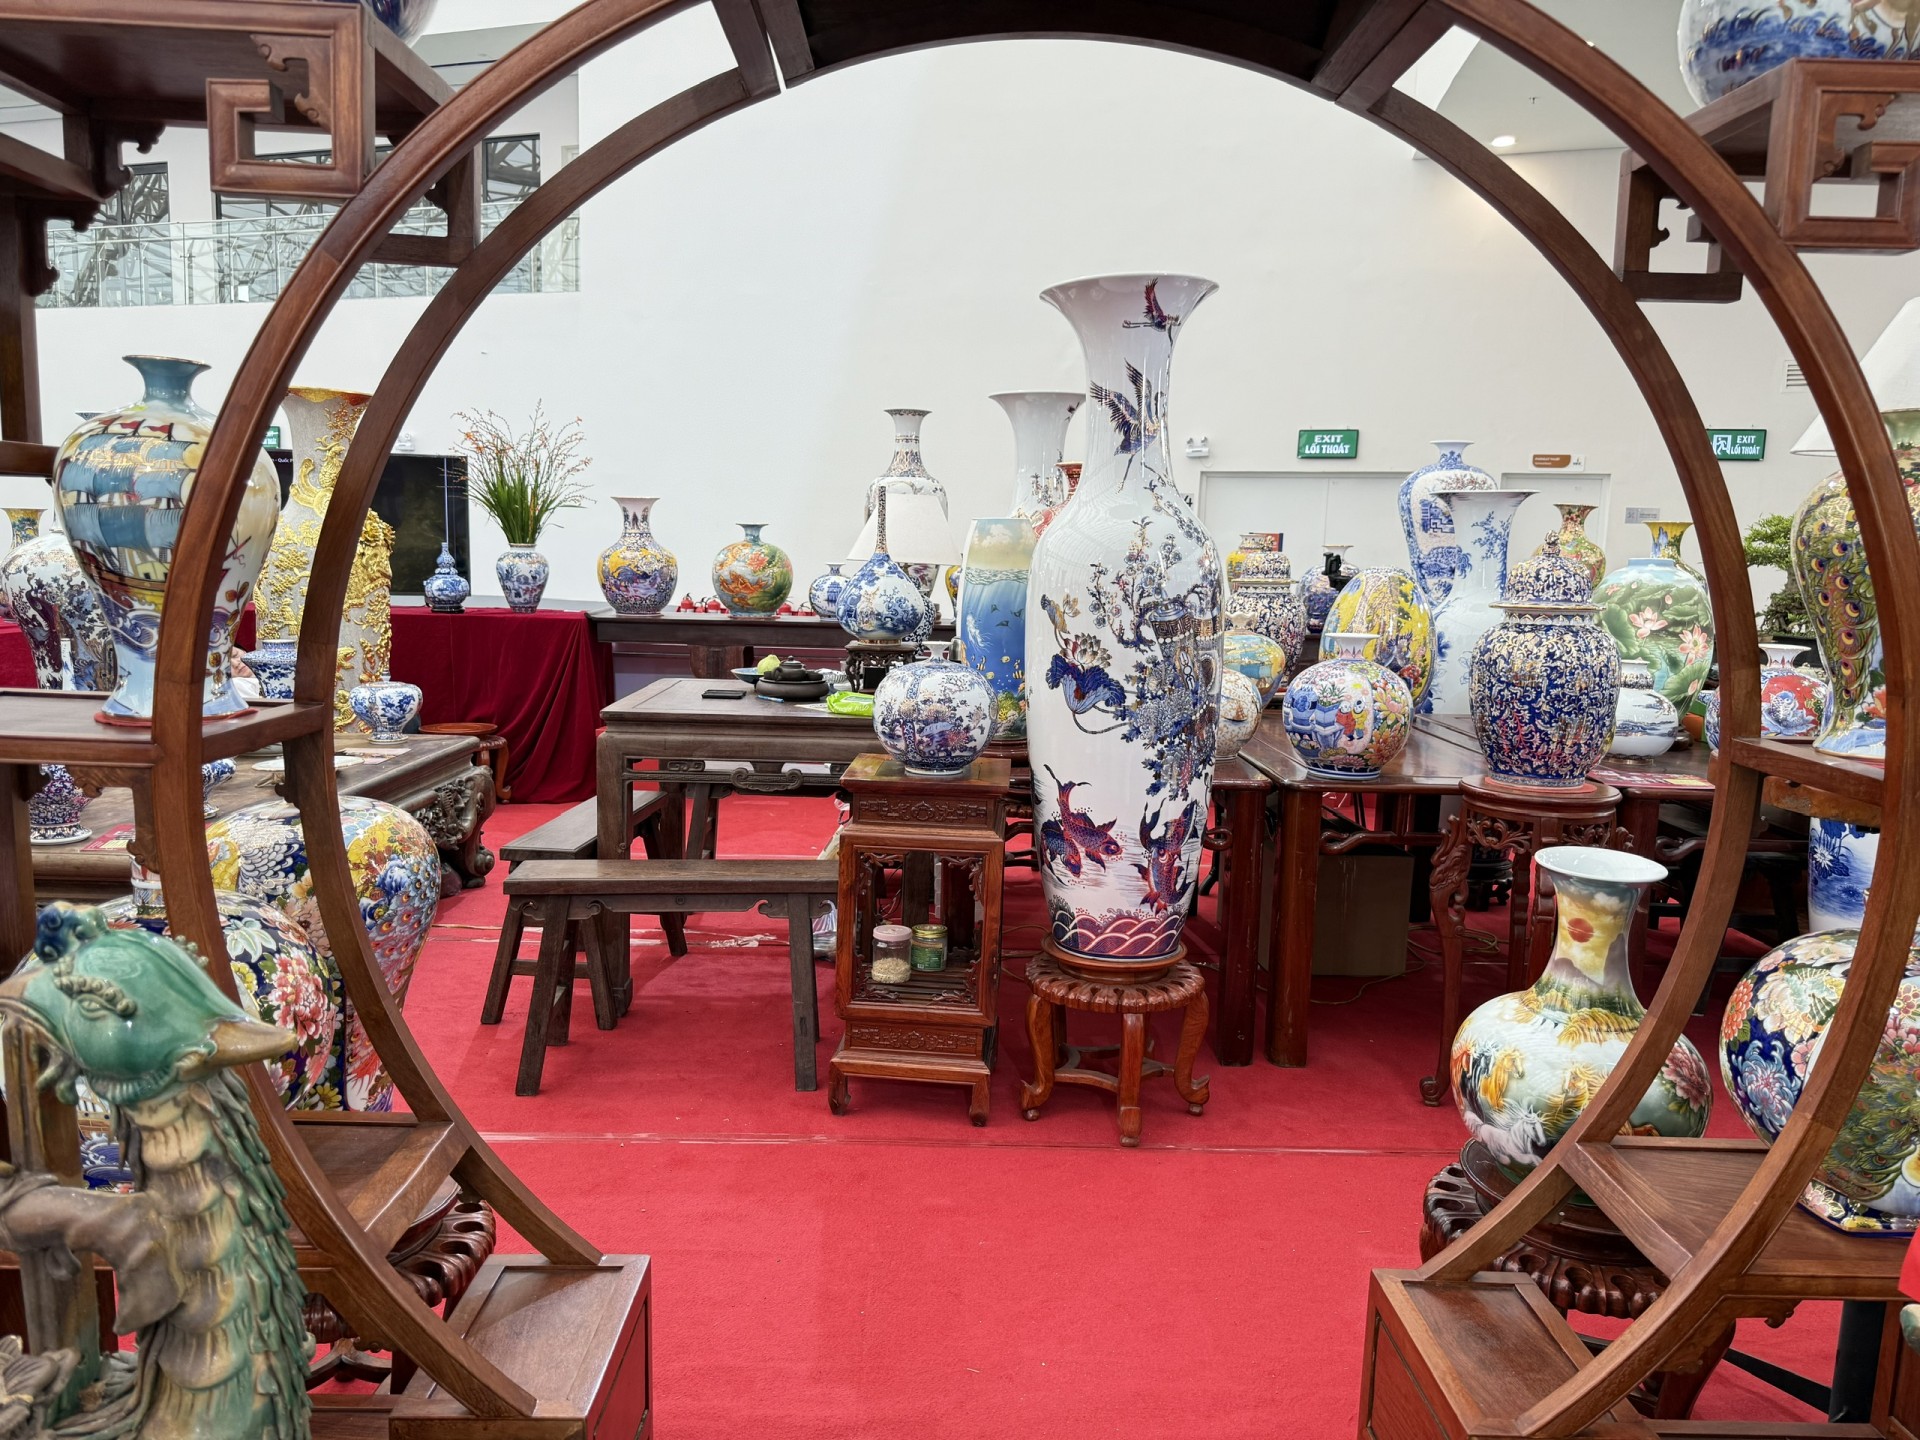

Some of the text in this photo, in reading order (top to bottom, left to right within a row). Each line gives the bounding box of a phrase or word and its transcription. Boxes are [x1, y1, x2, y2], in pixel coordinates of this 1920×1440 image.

[1314, 434, 1343, 443] EXIT
[1737, 435, 1756, 443] EXIT
[1305, 441, 1350, 454] LỐI THOÁT
[1730, 444, 1760, 455] LỐI THOÁT
